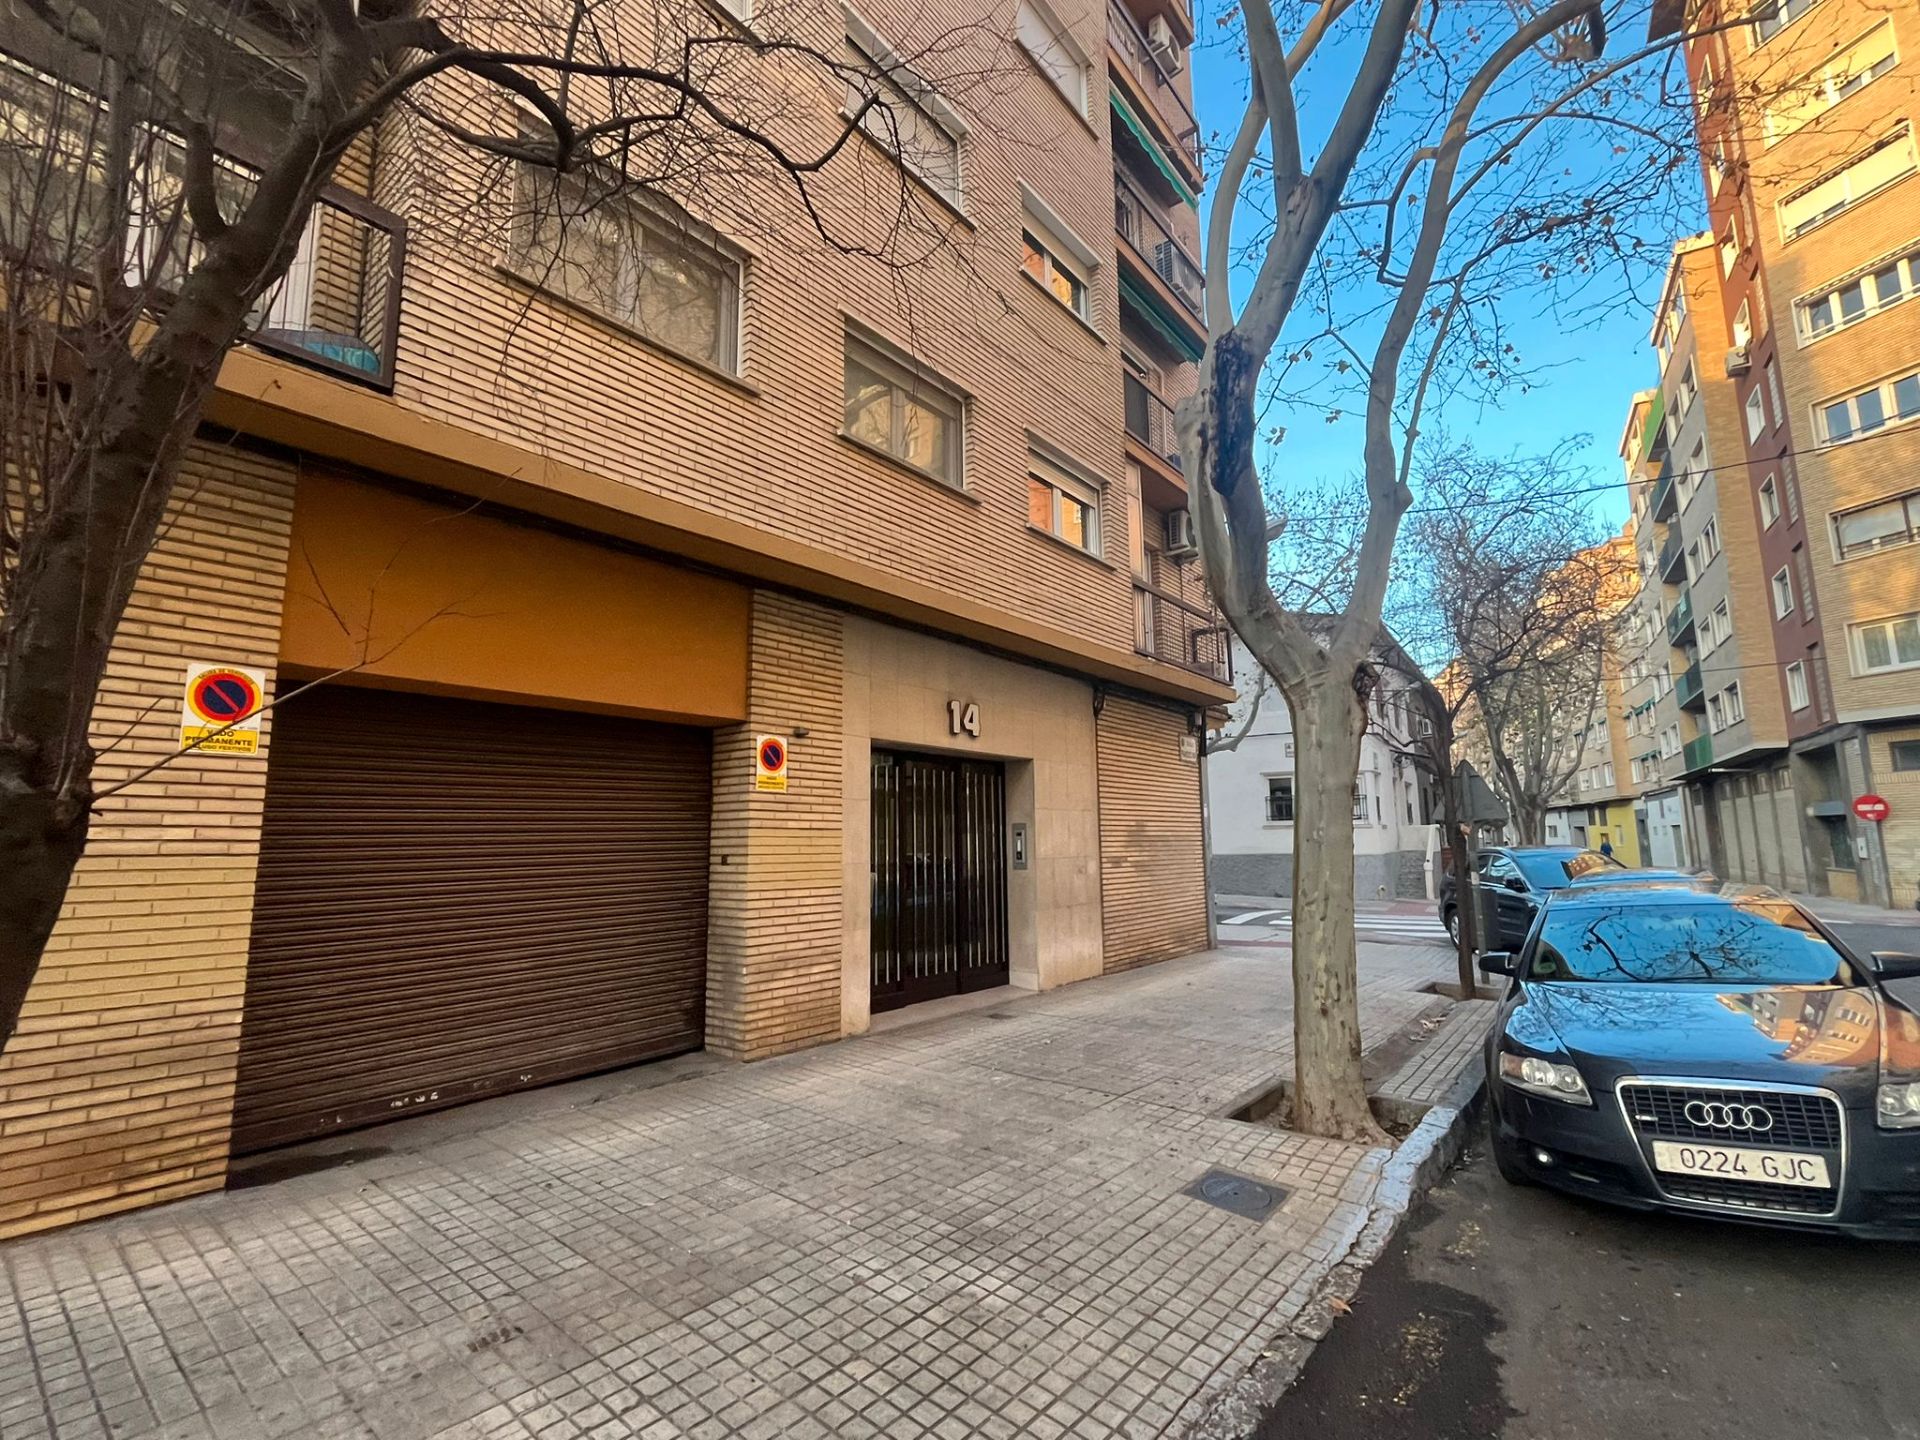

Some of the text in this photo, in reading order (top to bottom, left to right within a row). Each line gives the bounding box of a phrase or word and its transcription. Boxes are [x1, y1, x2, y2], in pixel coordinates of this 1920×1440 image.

[206, 729, 235, 737] VDO
[949, 700, 980, 737] 14
[1680, 1148, 1816, 1181] 0224 GJC
